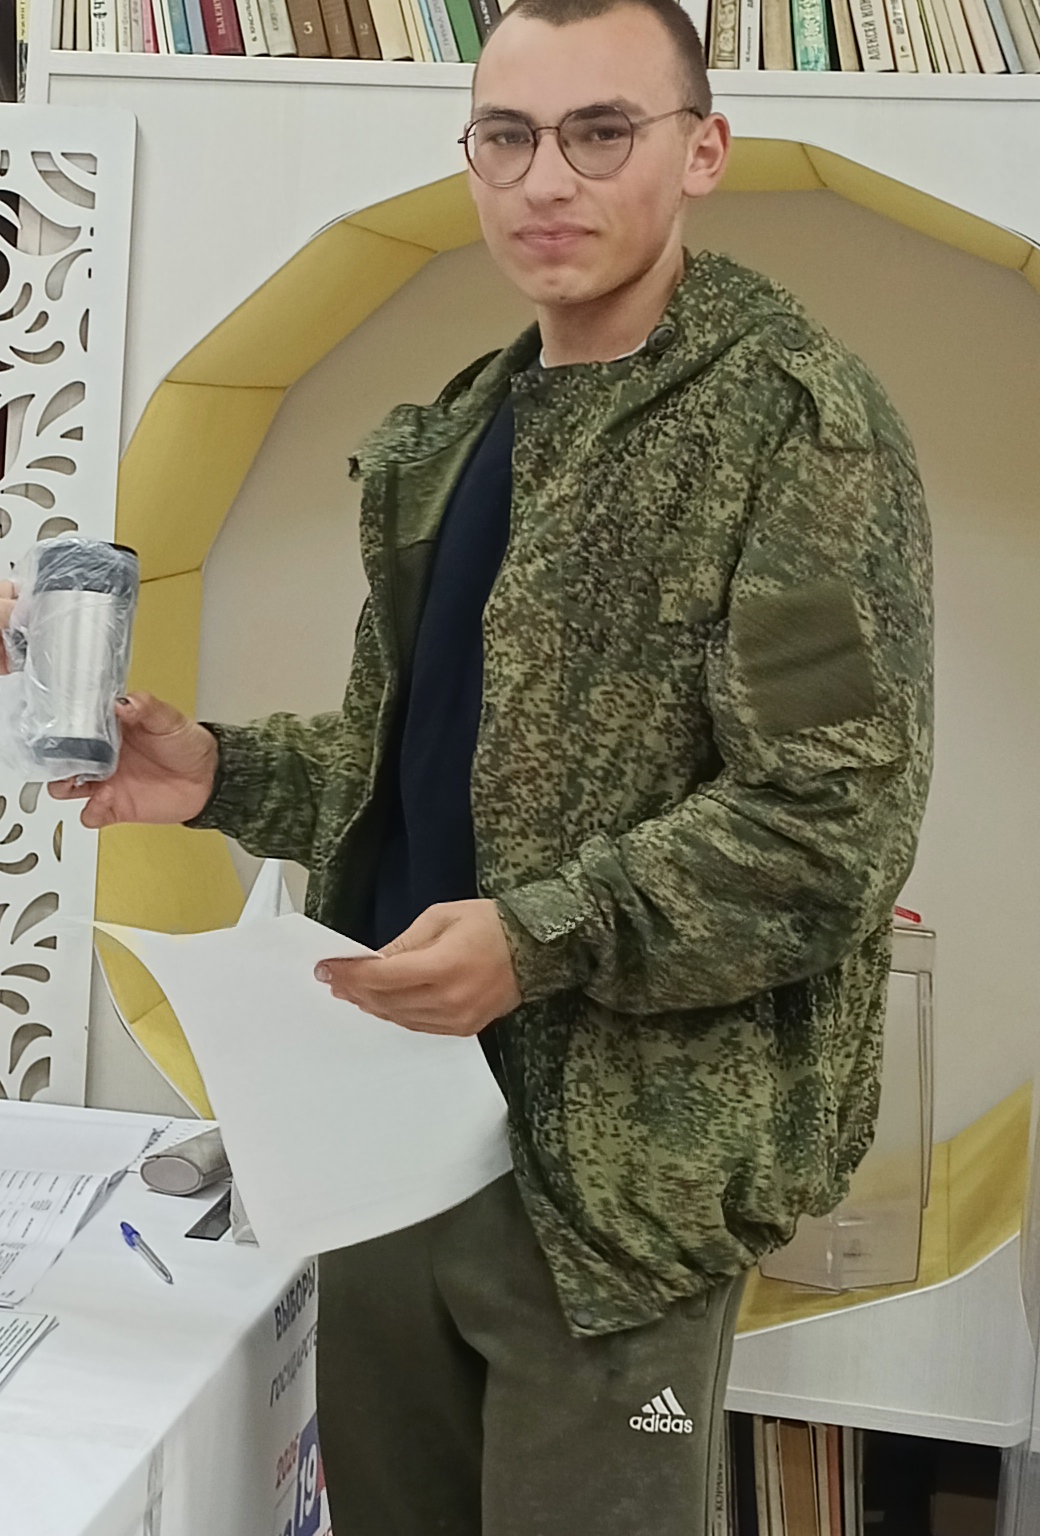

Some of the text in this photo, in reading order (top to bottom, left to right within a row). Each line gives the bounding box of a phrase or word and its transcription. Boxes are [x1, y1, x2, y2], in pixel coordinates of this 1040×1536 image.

[303, 21, 314, 35] 3
[862, 19, 880, 61] АЛЕКСЕЙ
[274, 1261, 316, 1342] ВЫБОРЫ
[629, 1413, 694, 1434] adidas
[297, 1443, 318, 1529] 19
